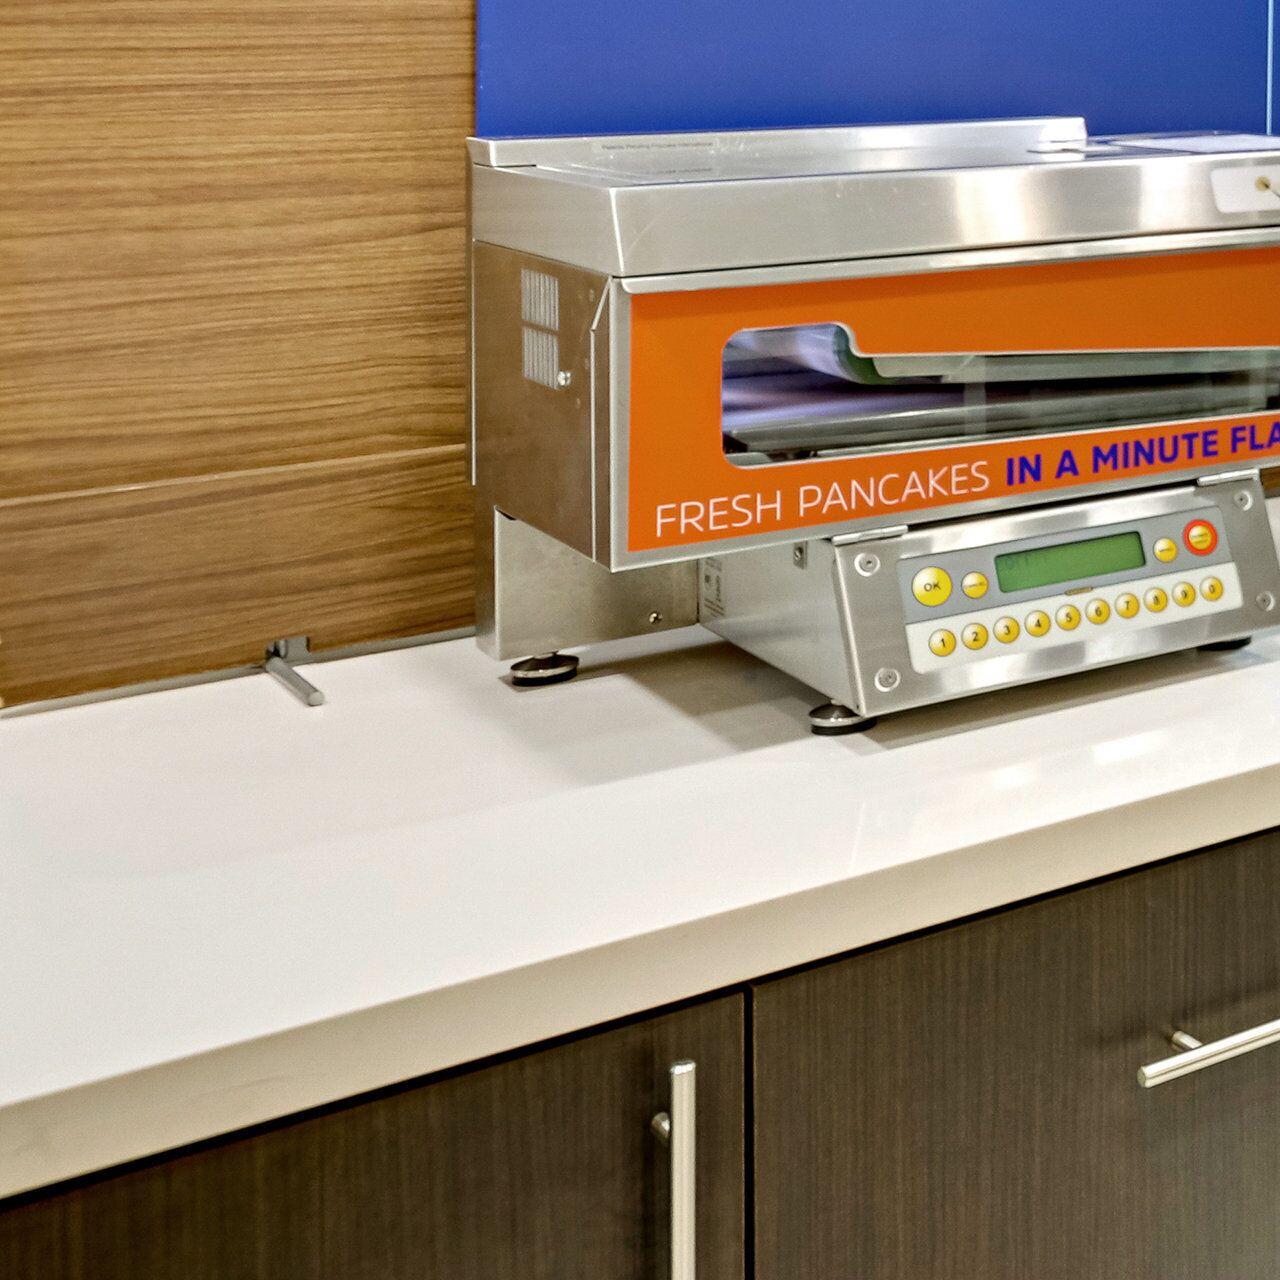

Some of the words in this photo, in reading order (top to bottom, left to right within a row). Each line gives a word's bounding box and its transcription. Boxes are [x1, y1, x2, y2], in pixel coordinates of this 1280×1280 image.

[655, 490, 782, 538] FRESH
[798, 460, 991, 518] PANCAKES
[1006, 454, 1043, 486] IN
[1055, 449, 1079, 479] A
[1092, 429, 1219, 474] MINUTE
[923, 582, 942, 592] OK
